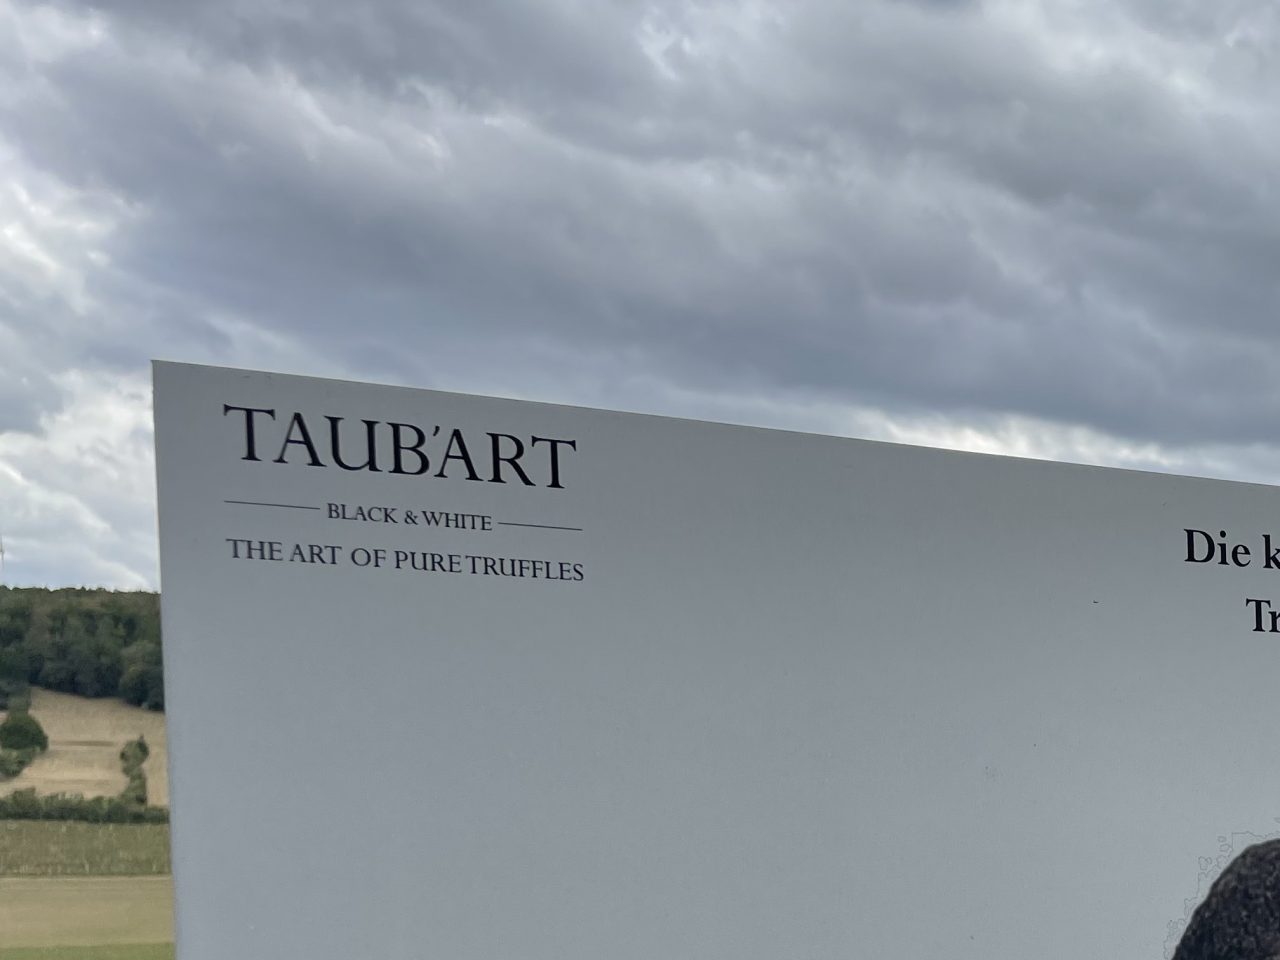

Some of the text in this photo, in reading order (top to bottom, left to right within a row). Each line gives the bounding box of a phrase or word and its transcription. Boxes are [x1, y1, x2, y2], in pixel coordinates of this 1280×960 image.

[327, 503, 492, 531] BLACK & WHITE
[226, 539, 584, 581] THE ART OF PURE TRUFFLES
[1184, 529, 1251, 567] Die
